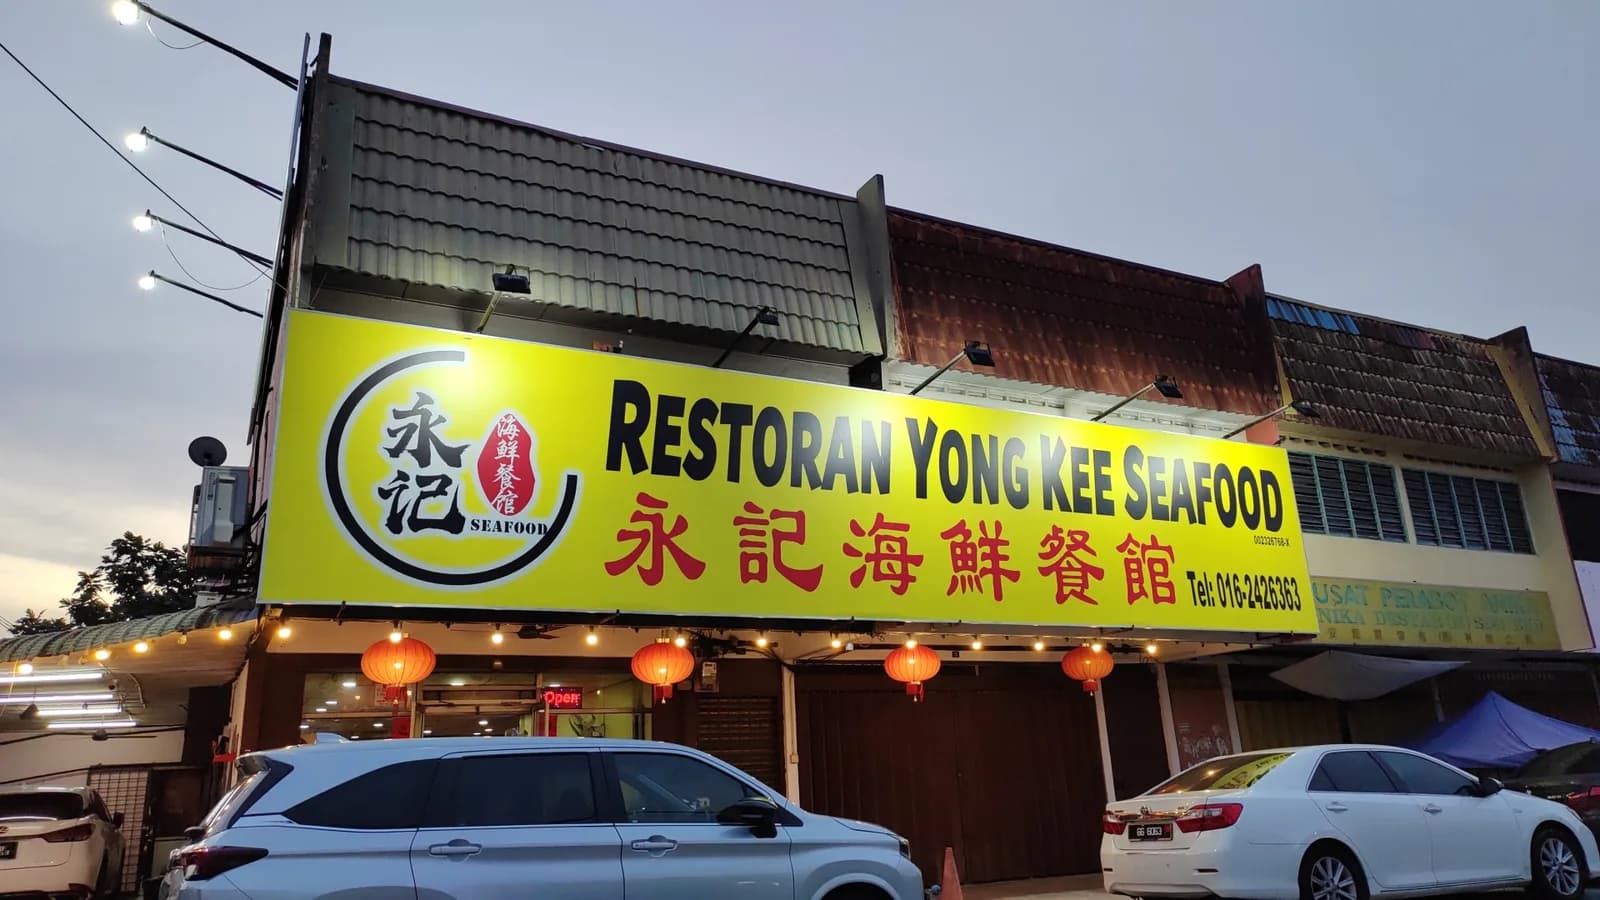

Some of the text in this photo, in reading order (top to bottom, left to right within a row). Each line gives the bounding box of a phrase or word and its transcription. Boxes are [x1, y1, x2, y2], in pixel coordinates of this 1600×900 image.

[377, 391, 471, 535] 永记
[606, 379, 1283, 532] RESTORAN YONG KEE SEAFOOD
[470, 518, 548, 536] SEAFOOD
[604, 491, 1176, 606] 永記海鮮餐館
[1186, 570, 1302, 611] Tel: 016-2426363
[544, 691, 579, 707] Open
